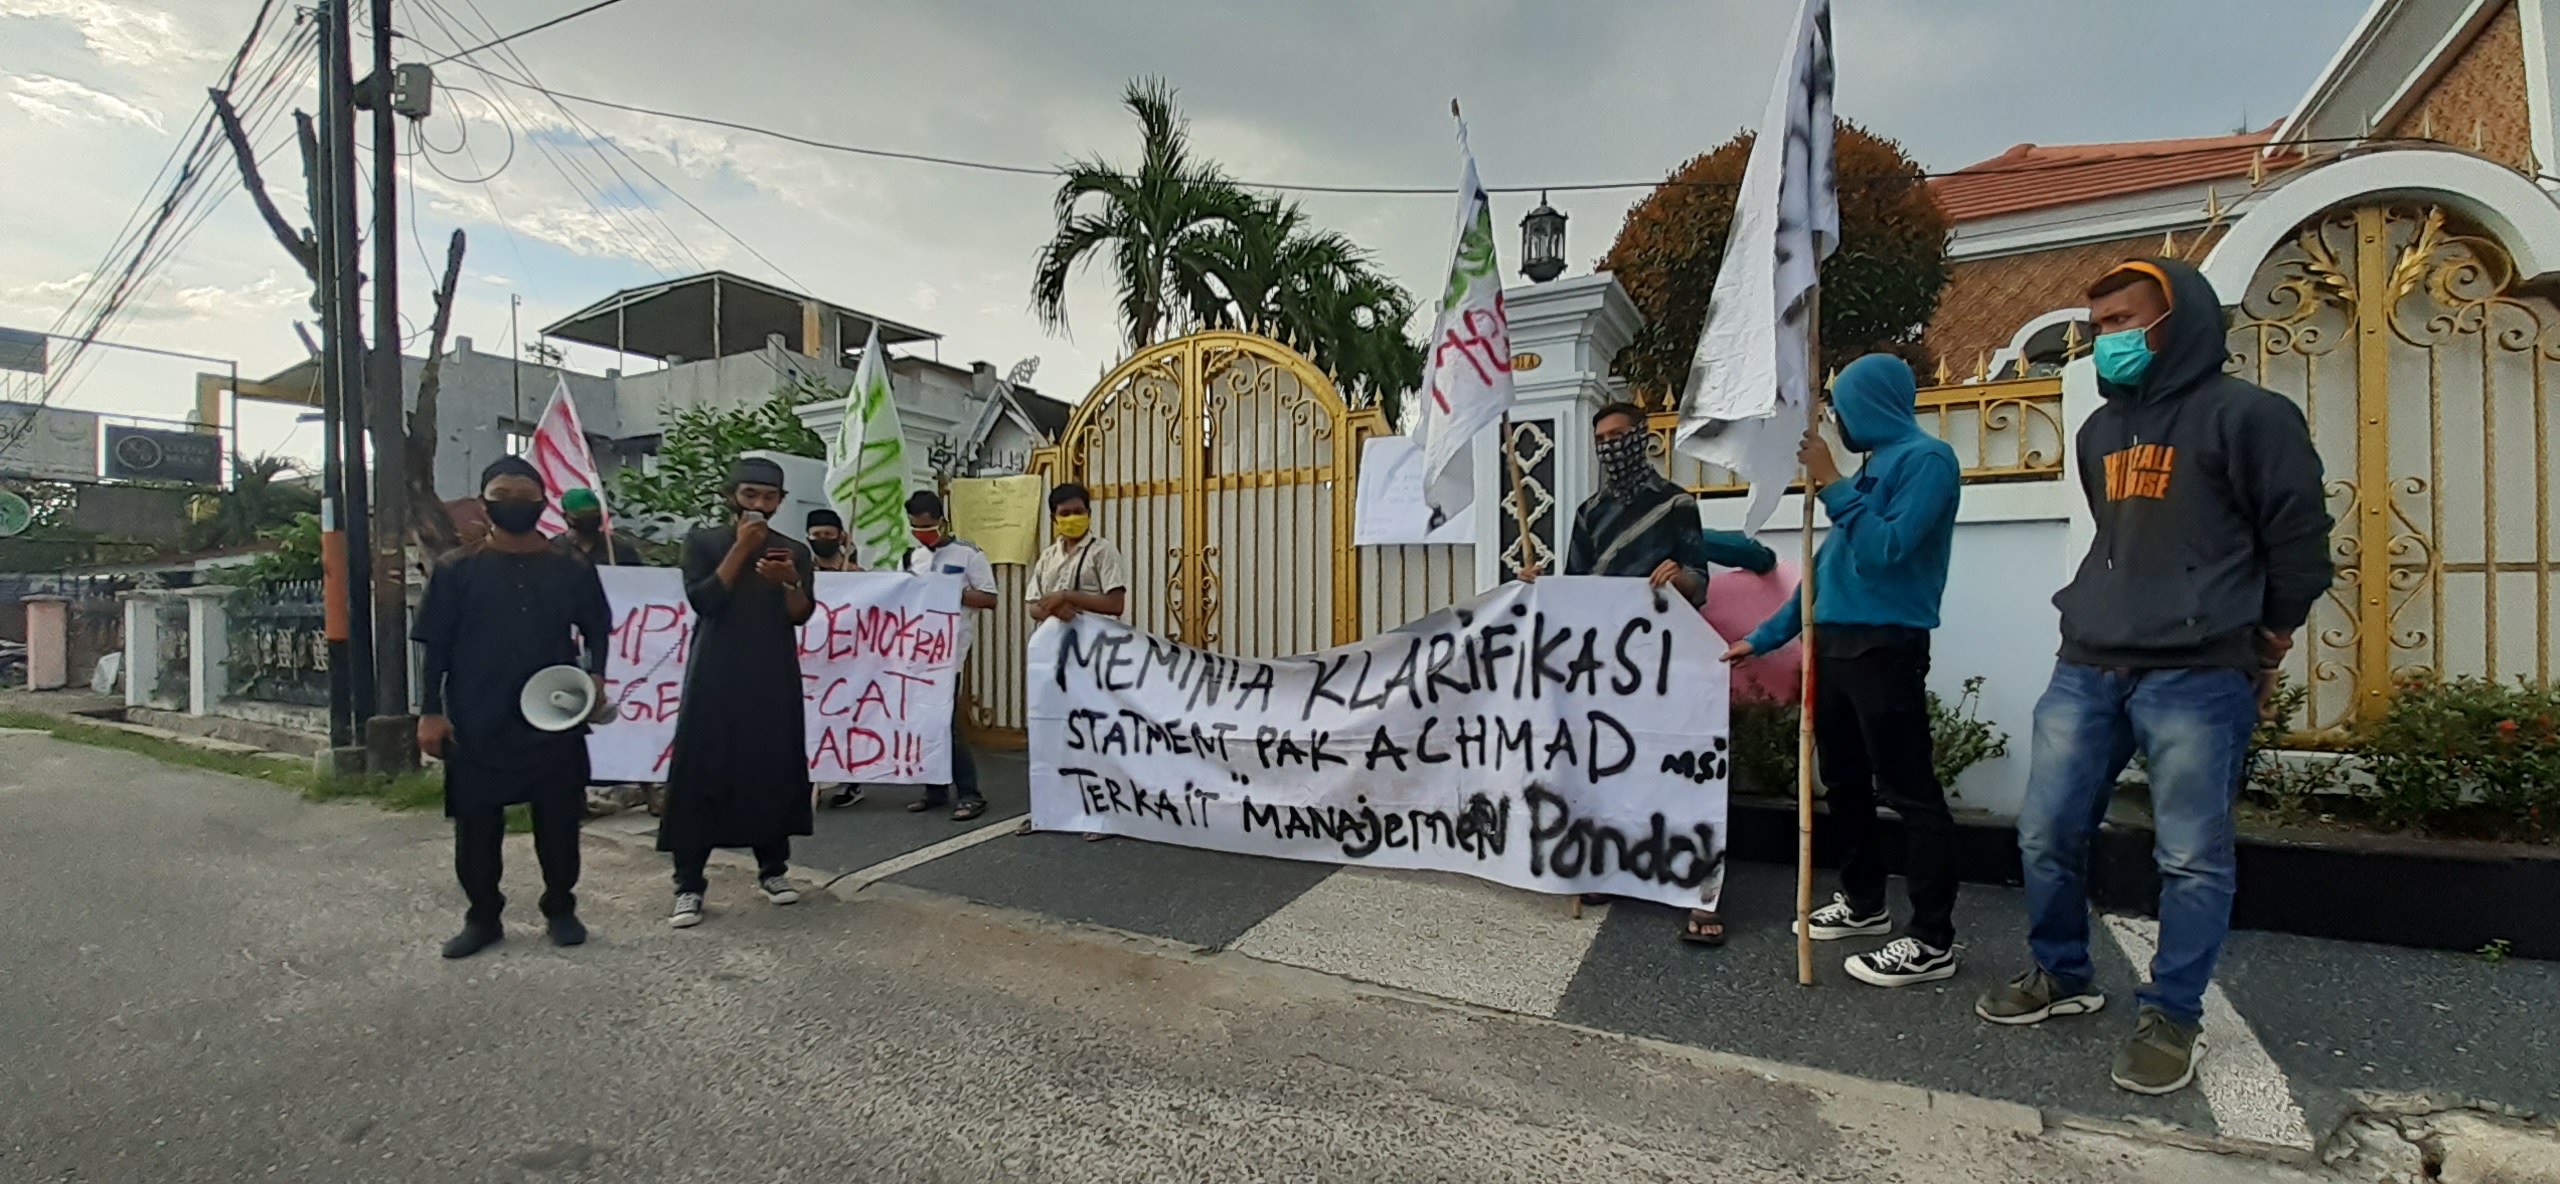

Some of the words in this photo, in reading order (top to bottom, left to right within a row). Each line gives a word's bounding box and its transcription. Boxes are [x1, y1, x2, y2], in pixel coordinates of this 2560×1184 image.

[1067, 708, 1238, 763] STATMENT
[1256, 725, 1348, 772] PAK
[1364, 710, 1637, 784] ACHMAD
